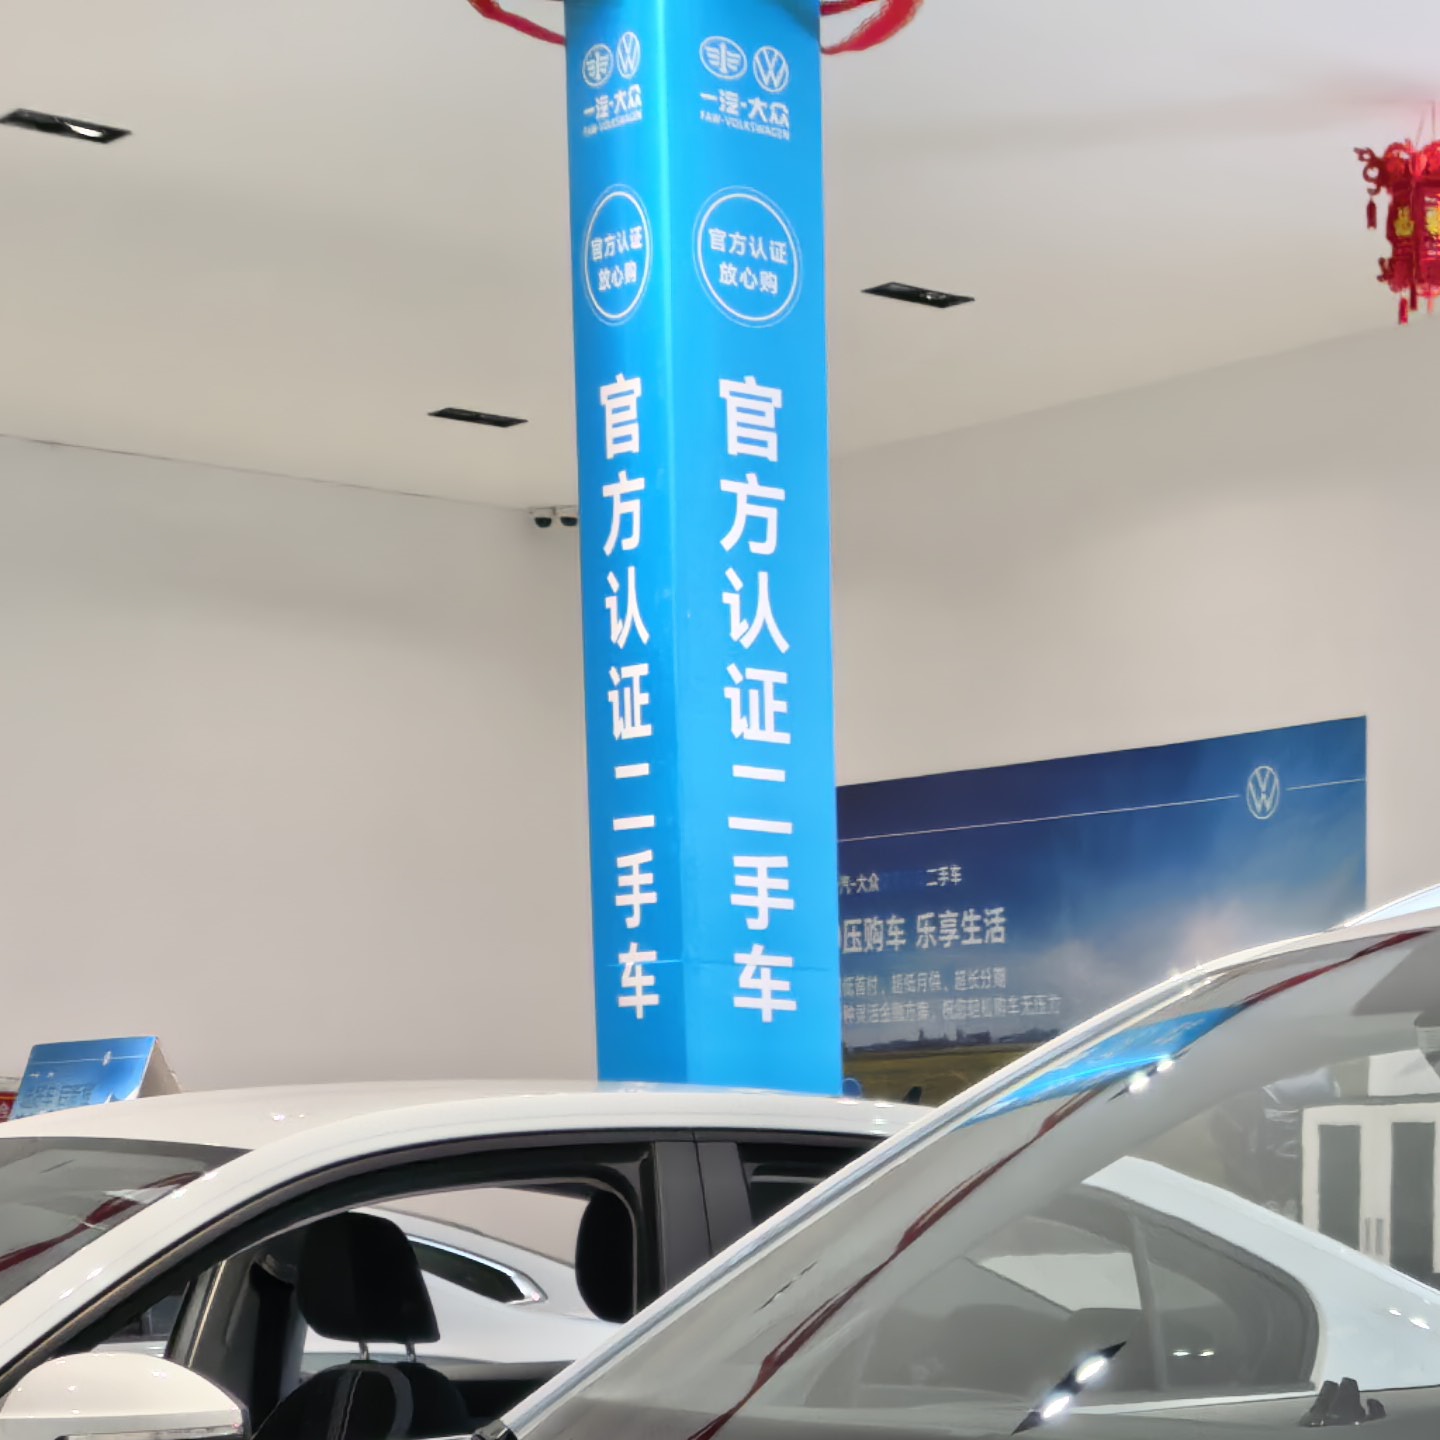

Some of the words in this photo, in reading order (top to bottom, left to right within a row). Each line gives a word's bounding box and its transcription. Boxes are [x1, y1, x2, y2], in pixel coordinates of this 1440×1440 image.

[591, 226, 644, 262] 官方认证
[708, 227, 788, 265] 官方认证
[598, 260, 637, 292] 放心购
[719, 262, 779, 296] 放心购
[600, 373, 660, 1020] 官方认证二手车
[719, 375, 798, 1023] 官方认证二手车
[839, 914, 907, 953] 压购车
[915, 906, 1007, 949] 乐享生活
